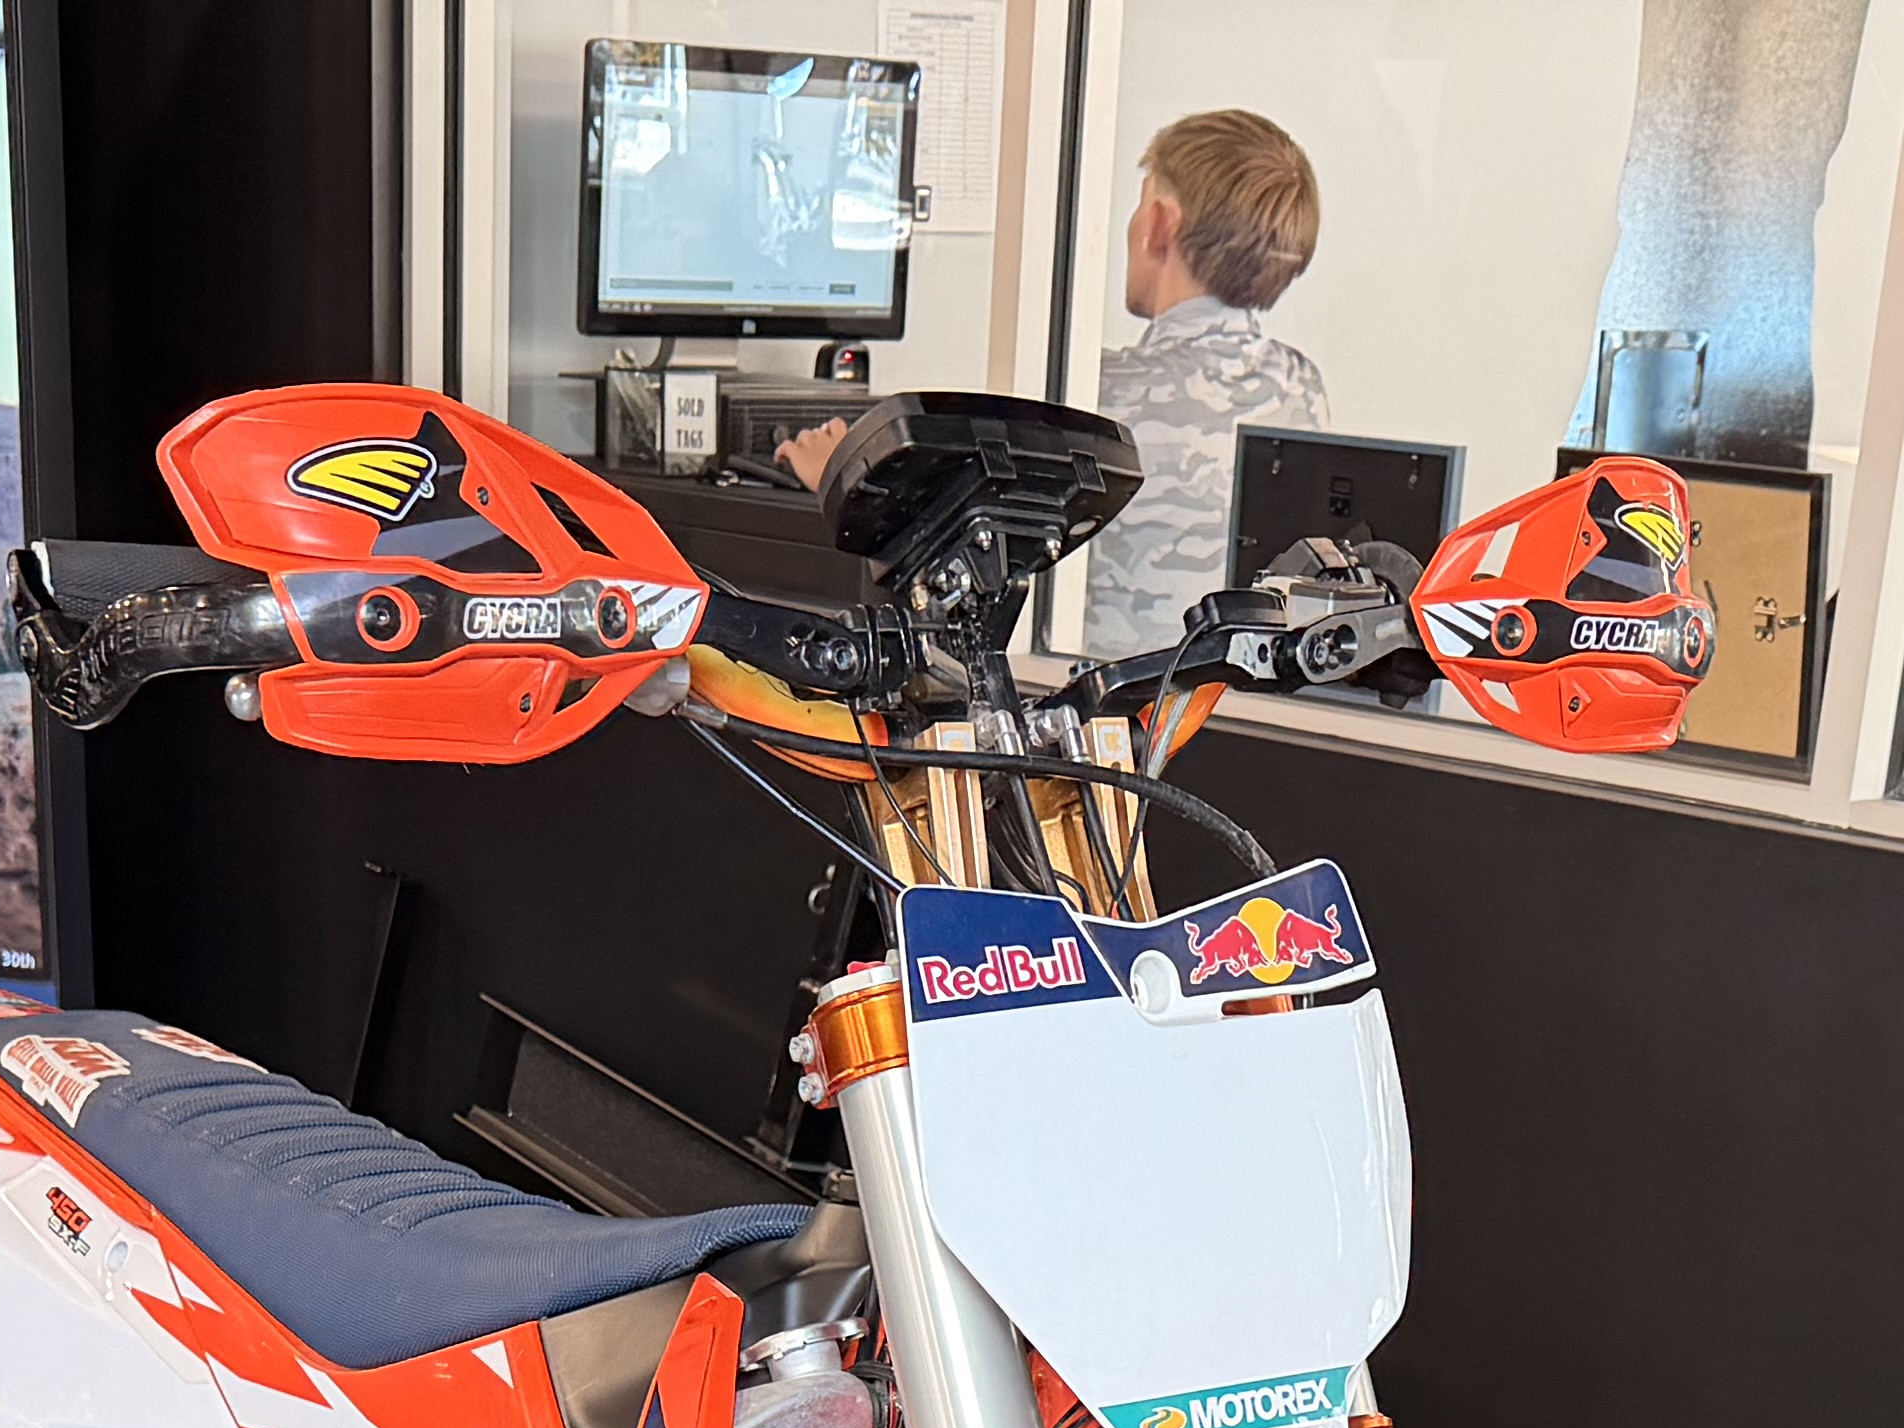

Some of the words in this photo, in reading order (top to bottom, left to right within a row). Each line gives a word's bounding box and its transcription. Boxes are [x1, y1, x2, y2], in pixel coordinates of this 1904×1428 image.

[677, 397, 705, 417] SOLD
[676, 429, 704, 449] TAGS
[463, 597, 562, 641] CYCRA
[1569, 615, 1660, 653] CYCRA
[1, 947, 37, 971] 30th
[917, 945, 1008, 1004] Red
[1001, 936, 1087, 993] Bull
[45, 1186, 93, 1235] 450
[48, 1216, 91, 1257] SX-F
